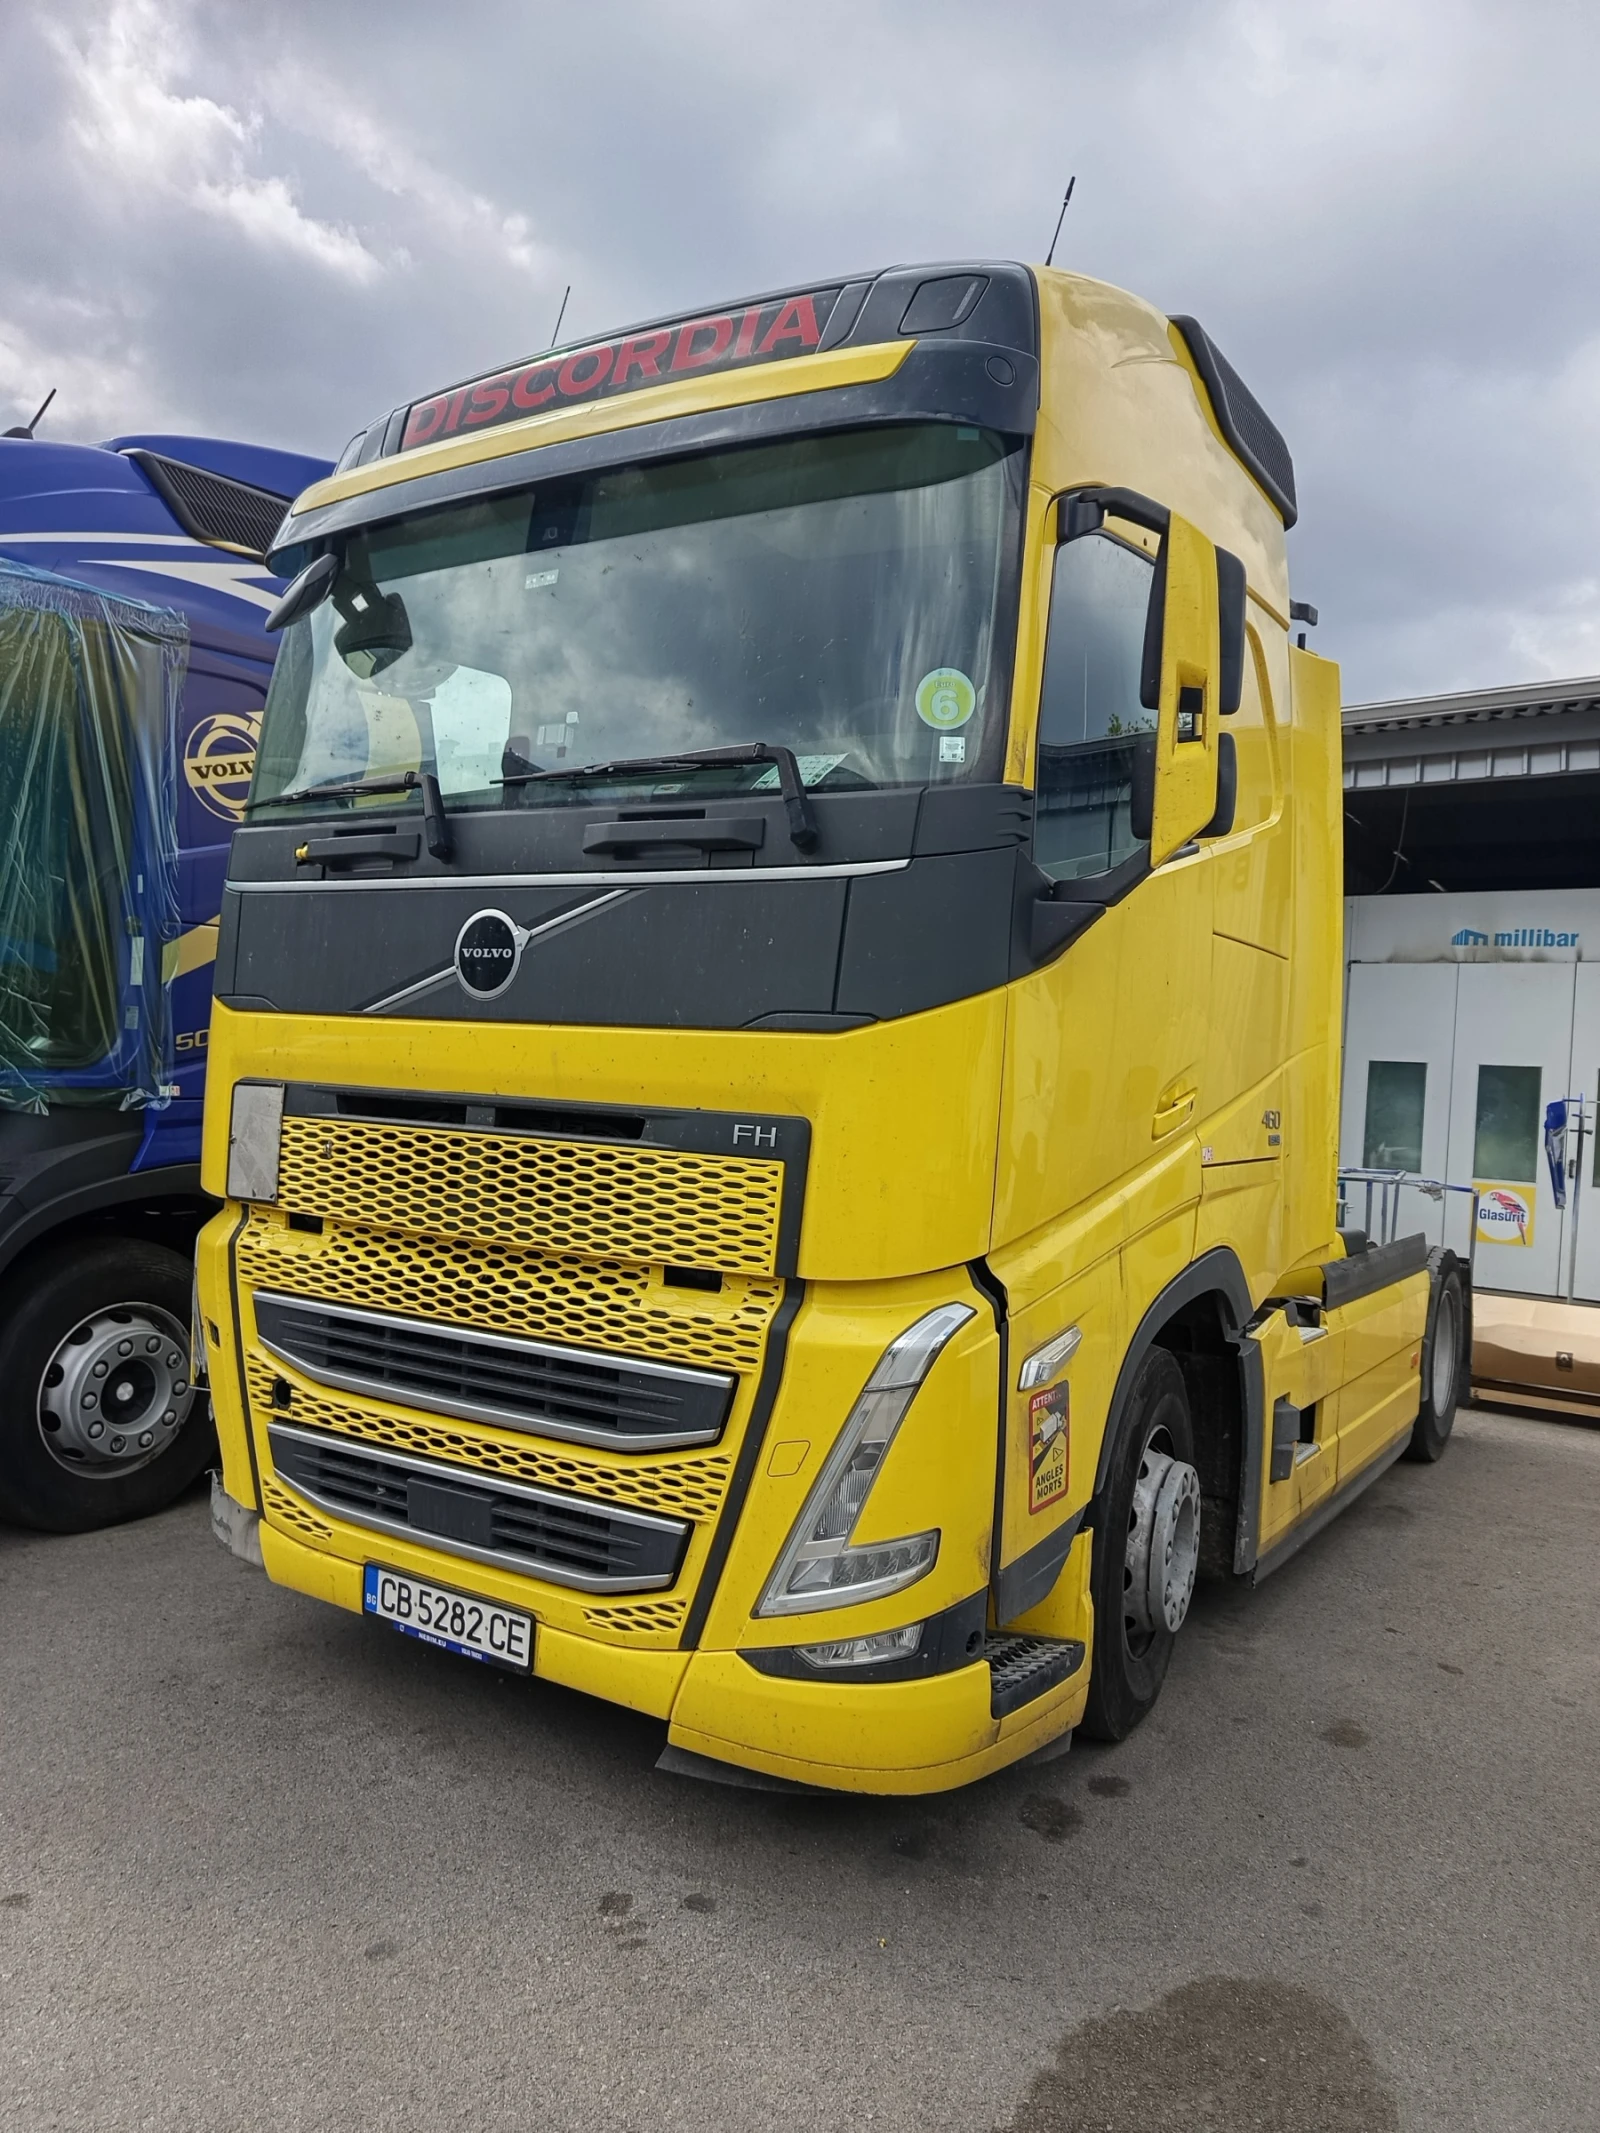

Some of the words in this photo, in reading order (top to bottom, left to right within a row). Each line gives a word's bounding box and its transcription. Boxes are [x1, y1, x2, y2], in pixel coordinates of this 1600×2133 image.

[401, 295, 820, 449] DISCORDIA
[930, 689, 960, 721] 6
[191, 760, 255, 779] VOLV
[1494, 929, 1579, 947] millibar
[462, 948, 512, 958] VOLVO
[175, 1029, 210, 1051] 50
[1261, 1110, 1281, 1130] 460
[732, 1124, 777, 1147] FH
[1479, 1208, 1526, 1224] Glasurit
[1032, 1390, 1062, 1411] ATTENT
[1036, 1464, 1063, 1489] ANGLES
[1037, 1477, 1062, 1500] MORTS
[366, 1593, 377, 1605] BG
